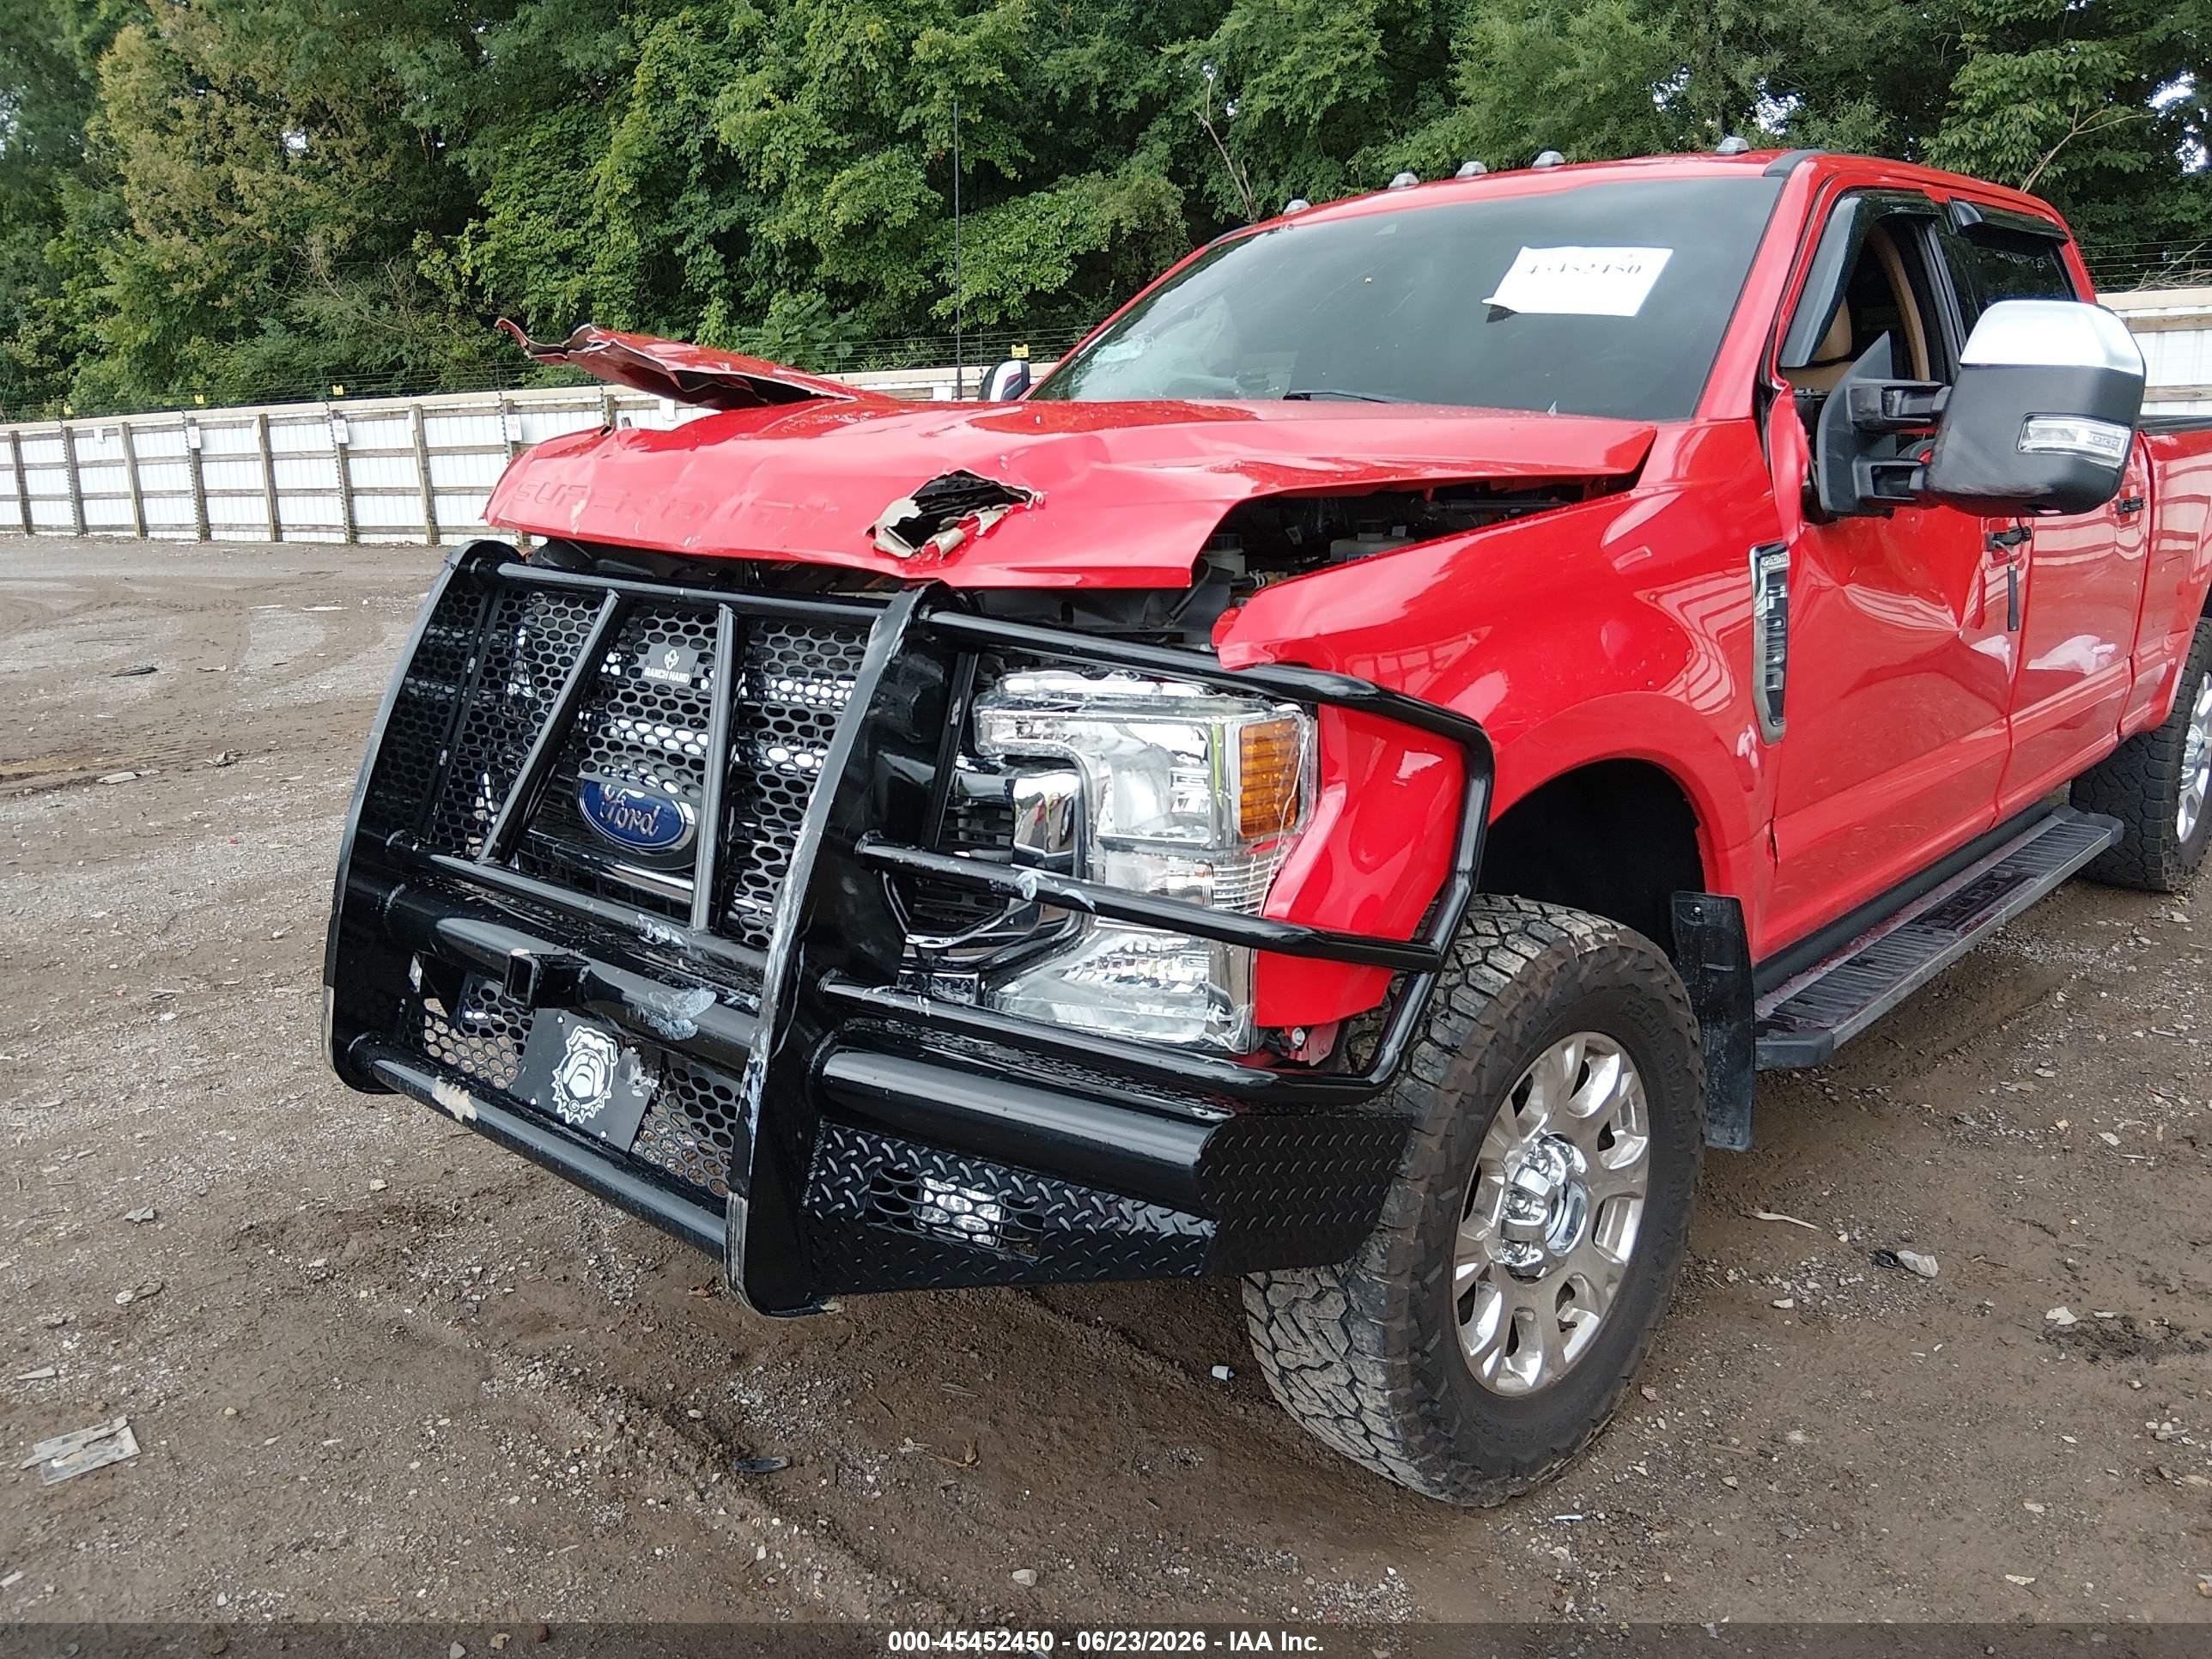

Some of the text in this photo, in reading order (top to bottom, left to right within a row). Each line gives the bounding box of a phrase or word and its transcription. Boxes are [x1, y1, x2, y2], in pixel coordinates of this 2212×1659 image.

[644, 666, 690, 684] RANCH HAND
[599, 786, 661, 837] Ford
